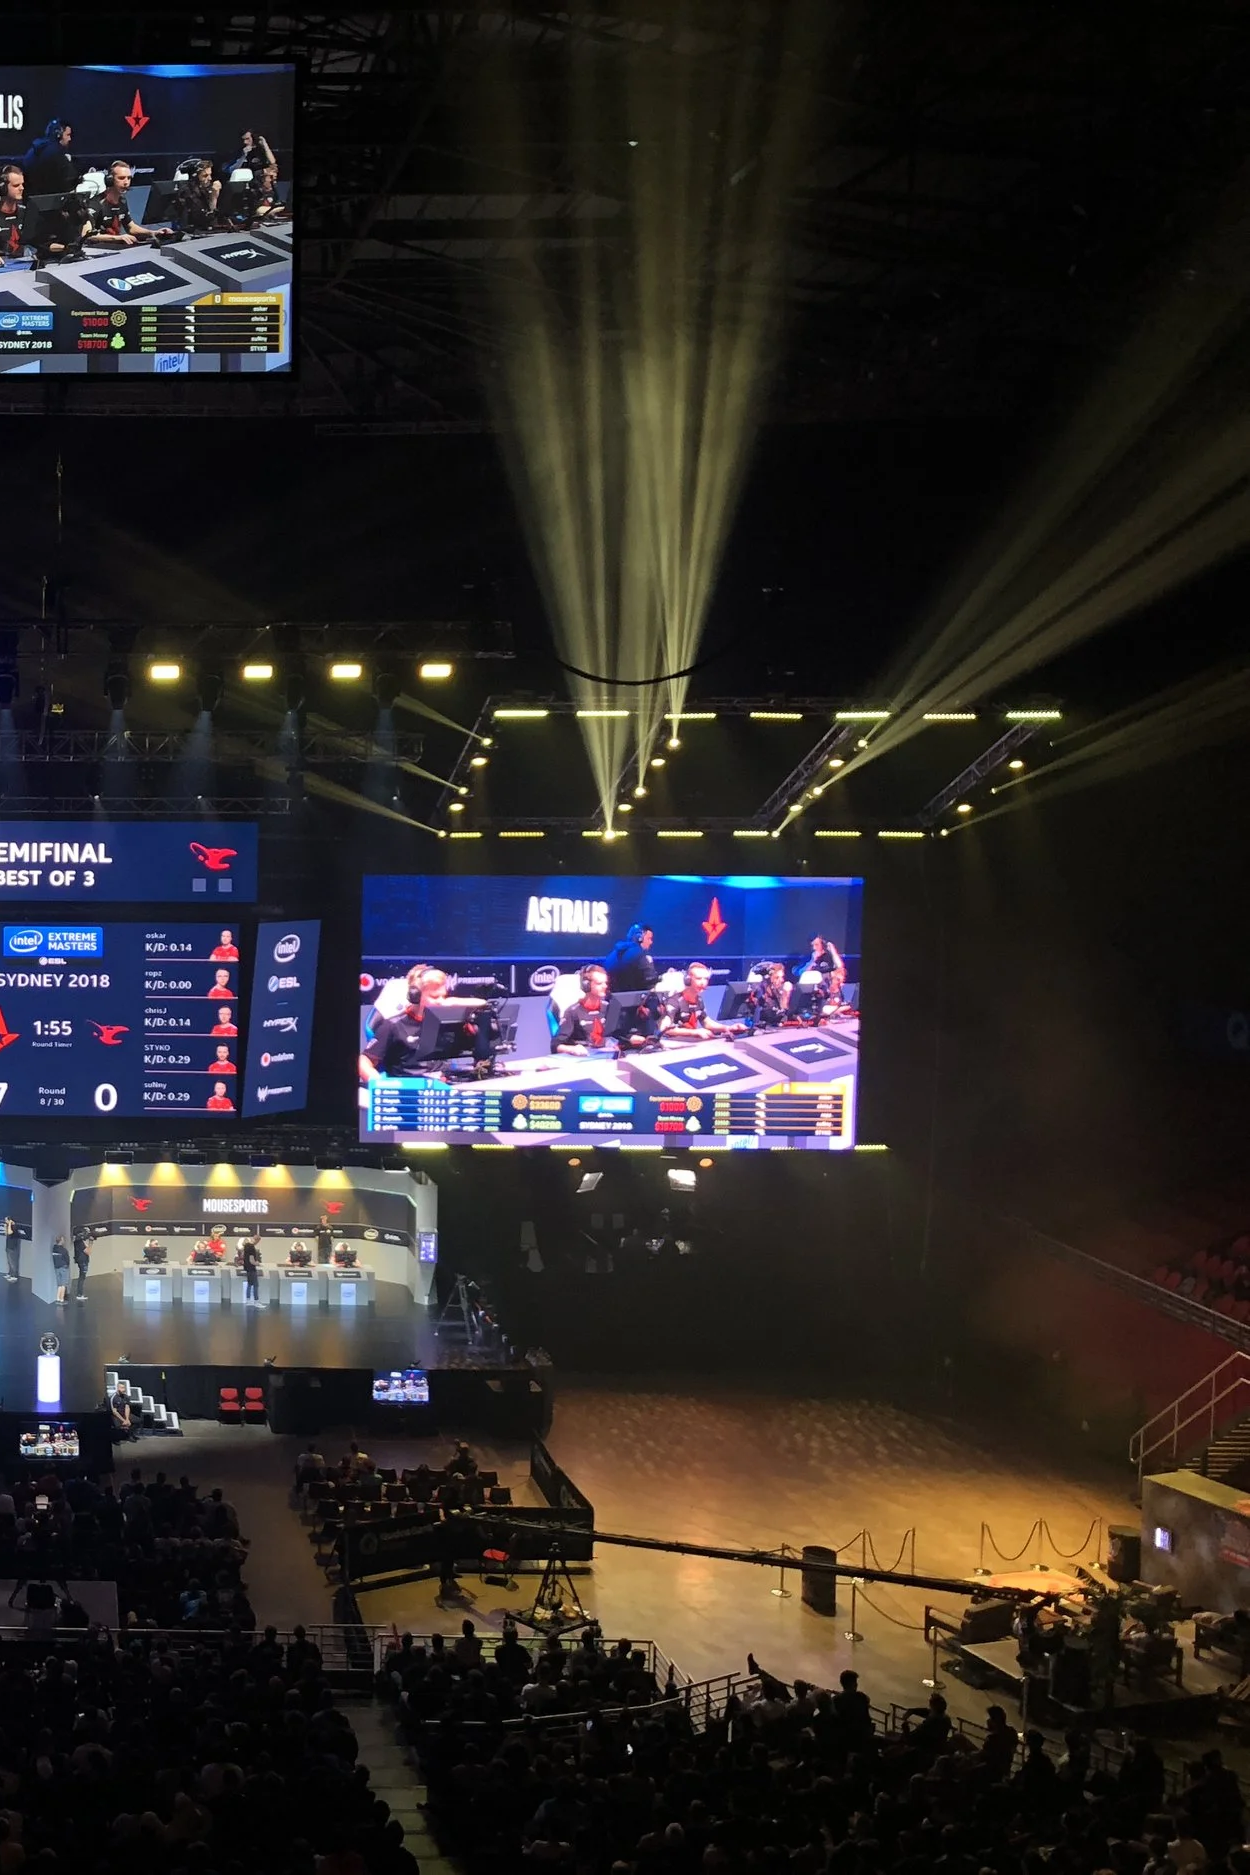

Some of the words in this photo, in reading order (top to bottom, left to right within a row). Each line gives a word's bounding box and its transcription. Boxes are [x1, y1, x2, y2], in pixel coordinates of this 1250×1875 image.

[131, 272, 165, 286] ESL
[215, 295, 221, 303] 0
[82, 318, 109, 327] $1000
[32, 341, 53, 349] 2018
[159, 356, 182, 371] intel
[49, 871, 75, 886] OF
[83, 871, 95, 887] 3
[526, 896, 609, 934] ASTRALIS
[48, 933, 97, 941] EXTREME
[48, 942, 97, 951] MASTERS
[145, 943, 168, 952] K/D:
[170, 943, 192, 952] 0.14
[68, 974, 110, 988] 2018
[145, 980, 167, 989] K/D:
[170, 980, 192, 989] 0.00
[279, 976, 300, 988] ESL
[144, 1018, 167, 1027] K/D:
[168, 1018, 191, 1027] 0.14
[33, 1020, 72, 1035] 1:55
[144, 1055, 166, 1064] K/D:
[168, 1055, 191, 1064] 0.29
[39, 1087, 66, 1095] Round
[94, 1083, 118, 1111] 0
[143, 1092, 166, 1101] K/D:
[168, 1092, 190, 1101] 0.29
[579, 1122, 611, 1130] SYDNEY
[203, 1199, 268, 1213] MOUSESPORTS
